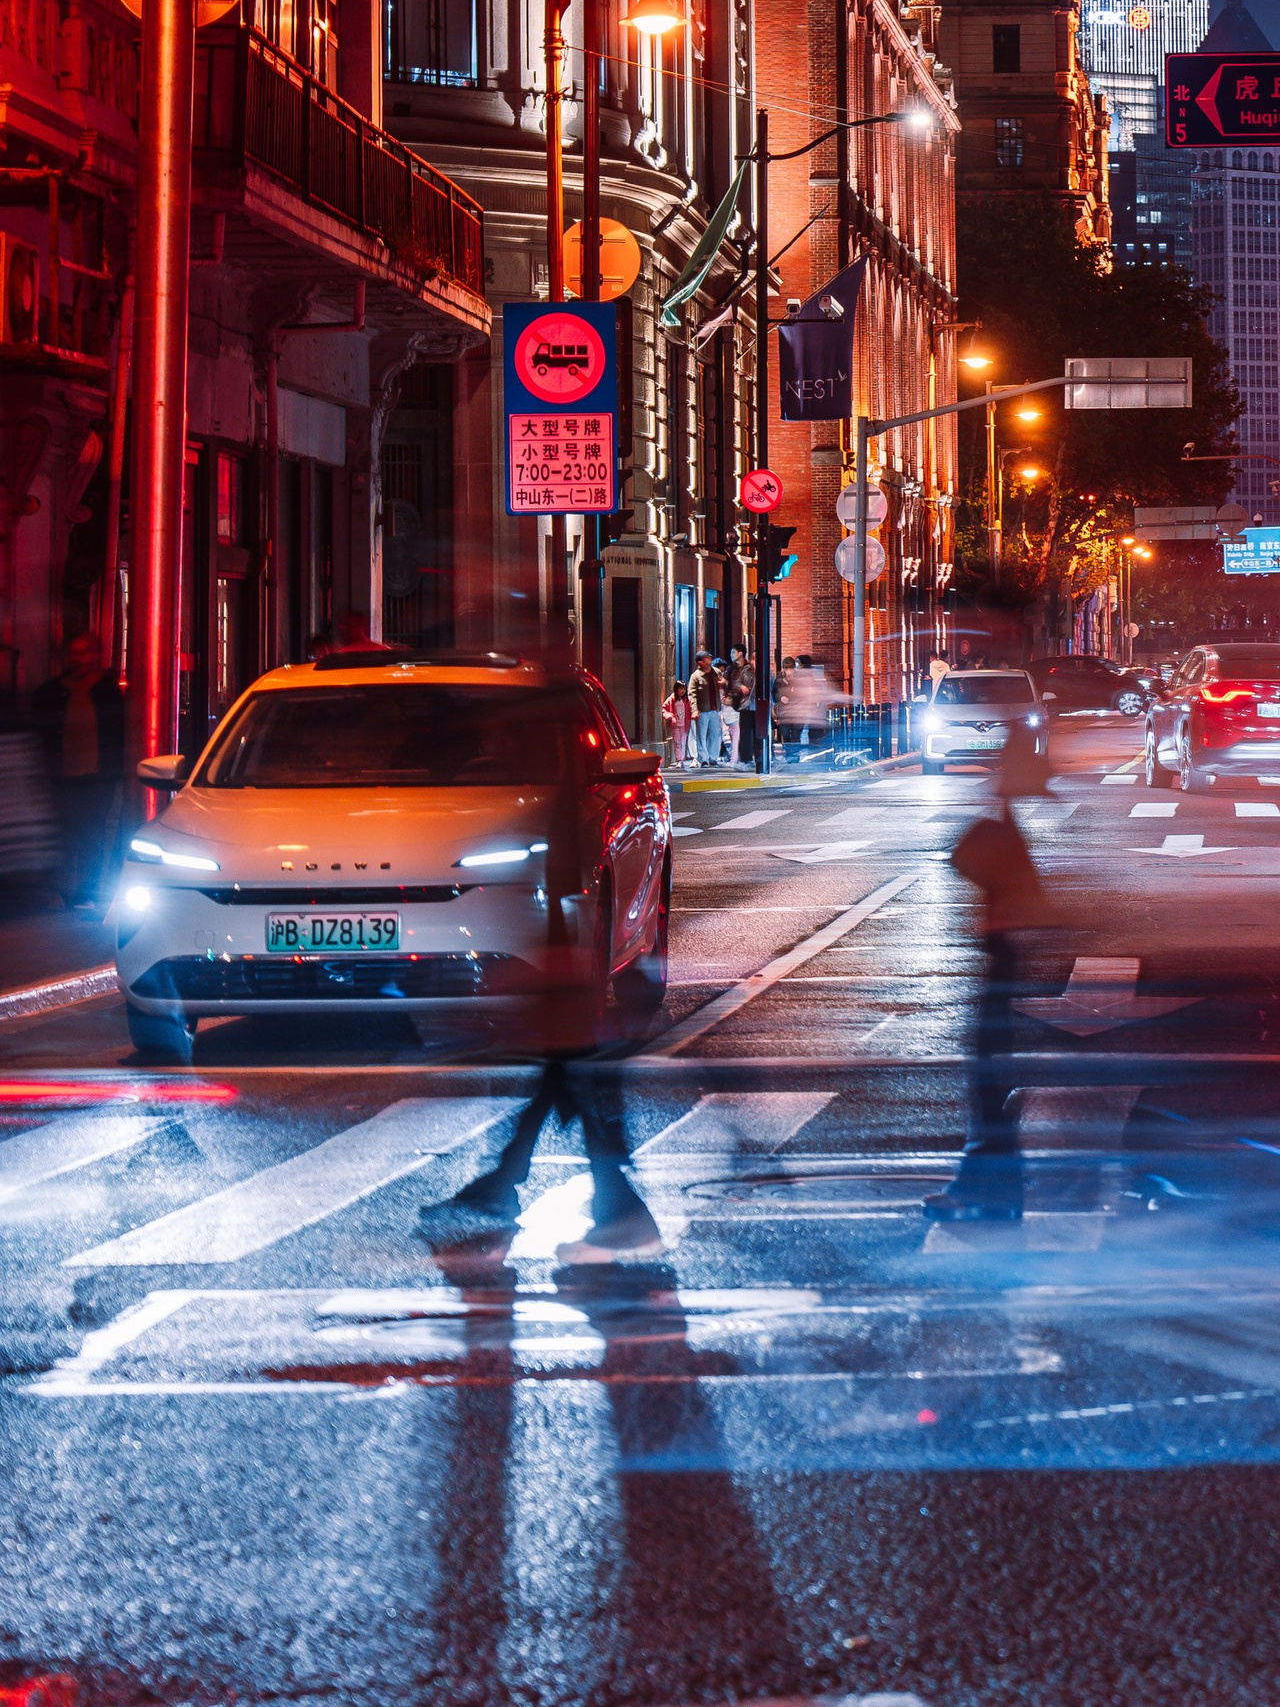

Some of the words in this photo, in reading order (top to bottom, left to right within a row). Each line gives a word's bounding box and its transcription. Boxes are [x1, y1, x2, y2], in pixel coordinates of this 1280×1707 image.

[1173, 84, 1191, 102] 北
[1179, 107, 1186, 117] N
[1175, 123, 1188, 143] 5
[786, 378, 834, 399] NEST
[521, 418, 602, 437] 大型号牌
[521, 443, 602, 461] 小型号牌
[515, 487, 608, 507] 中山东一(二)路
